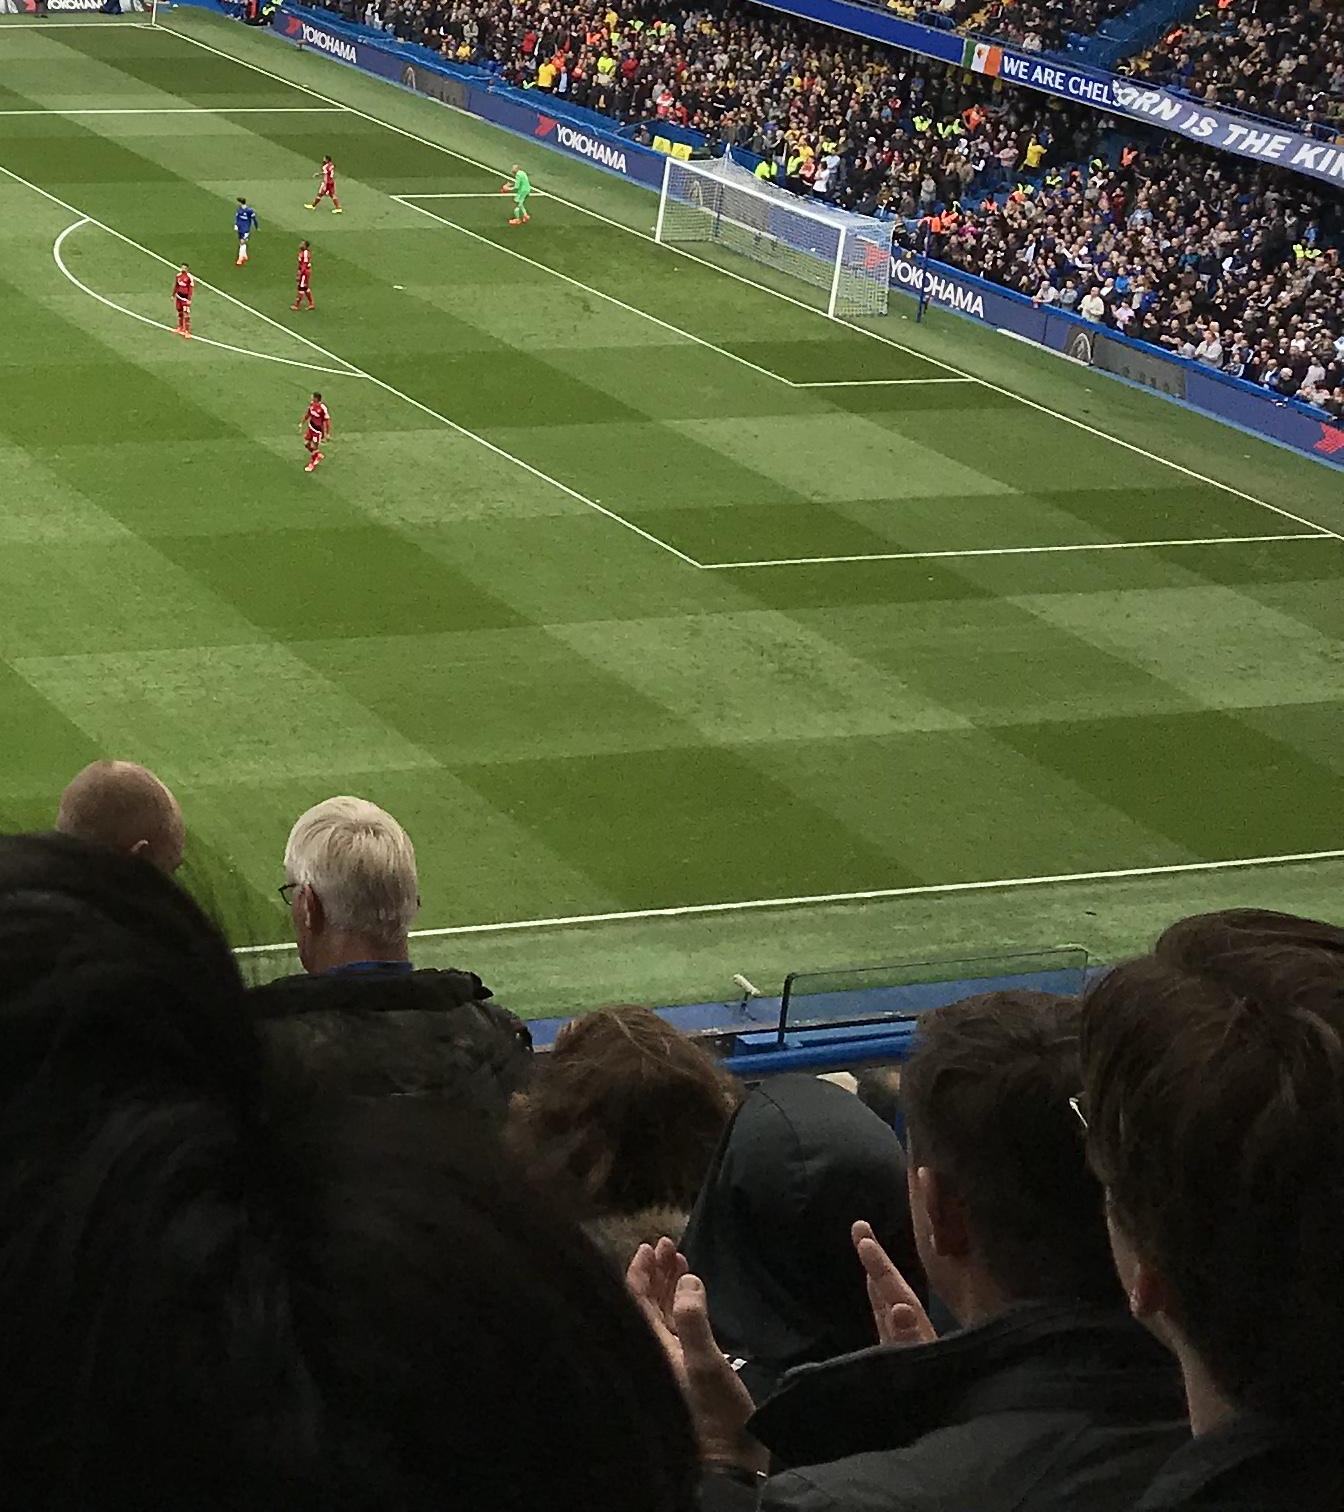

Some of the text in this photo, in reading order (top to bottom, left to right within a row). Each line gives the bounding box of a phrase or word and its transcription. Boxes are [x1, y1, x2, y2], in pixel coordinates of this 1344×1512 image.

[302, 23, 358, 65] YOKOHAMA
[1003, 55, 1030, 80] WE
[1030, 65, 1066, 90] ARE
[556, 124, 628, 174] YOKOHAMA
[1179, 111, 1218, 137] IS
[1222, 123, 1293, 159] THE
